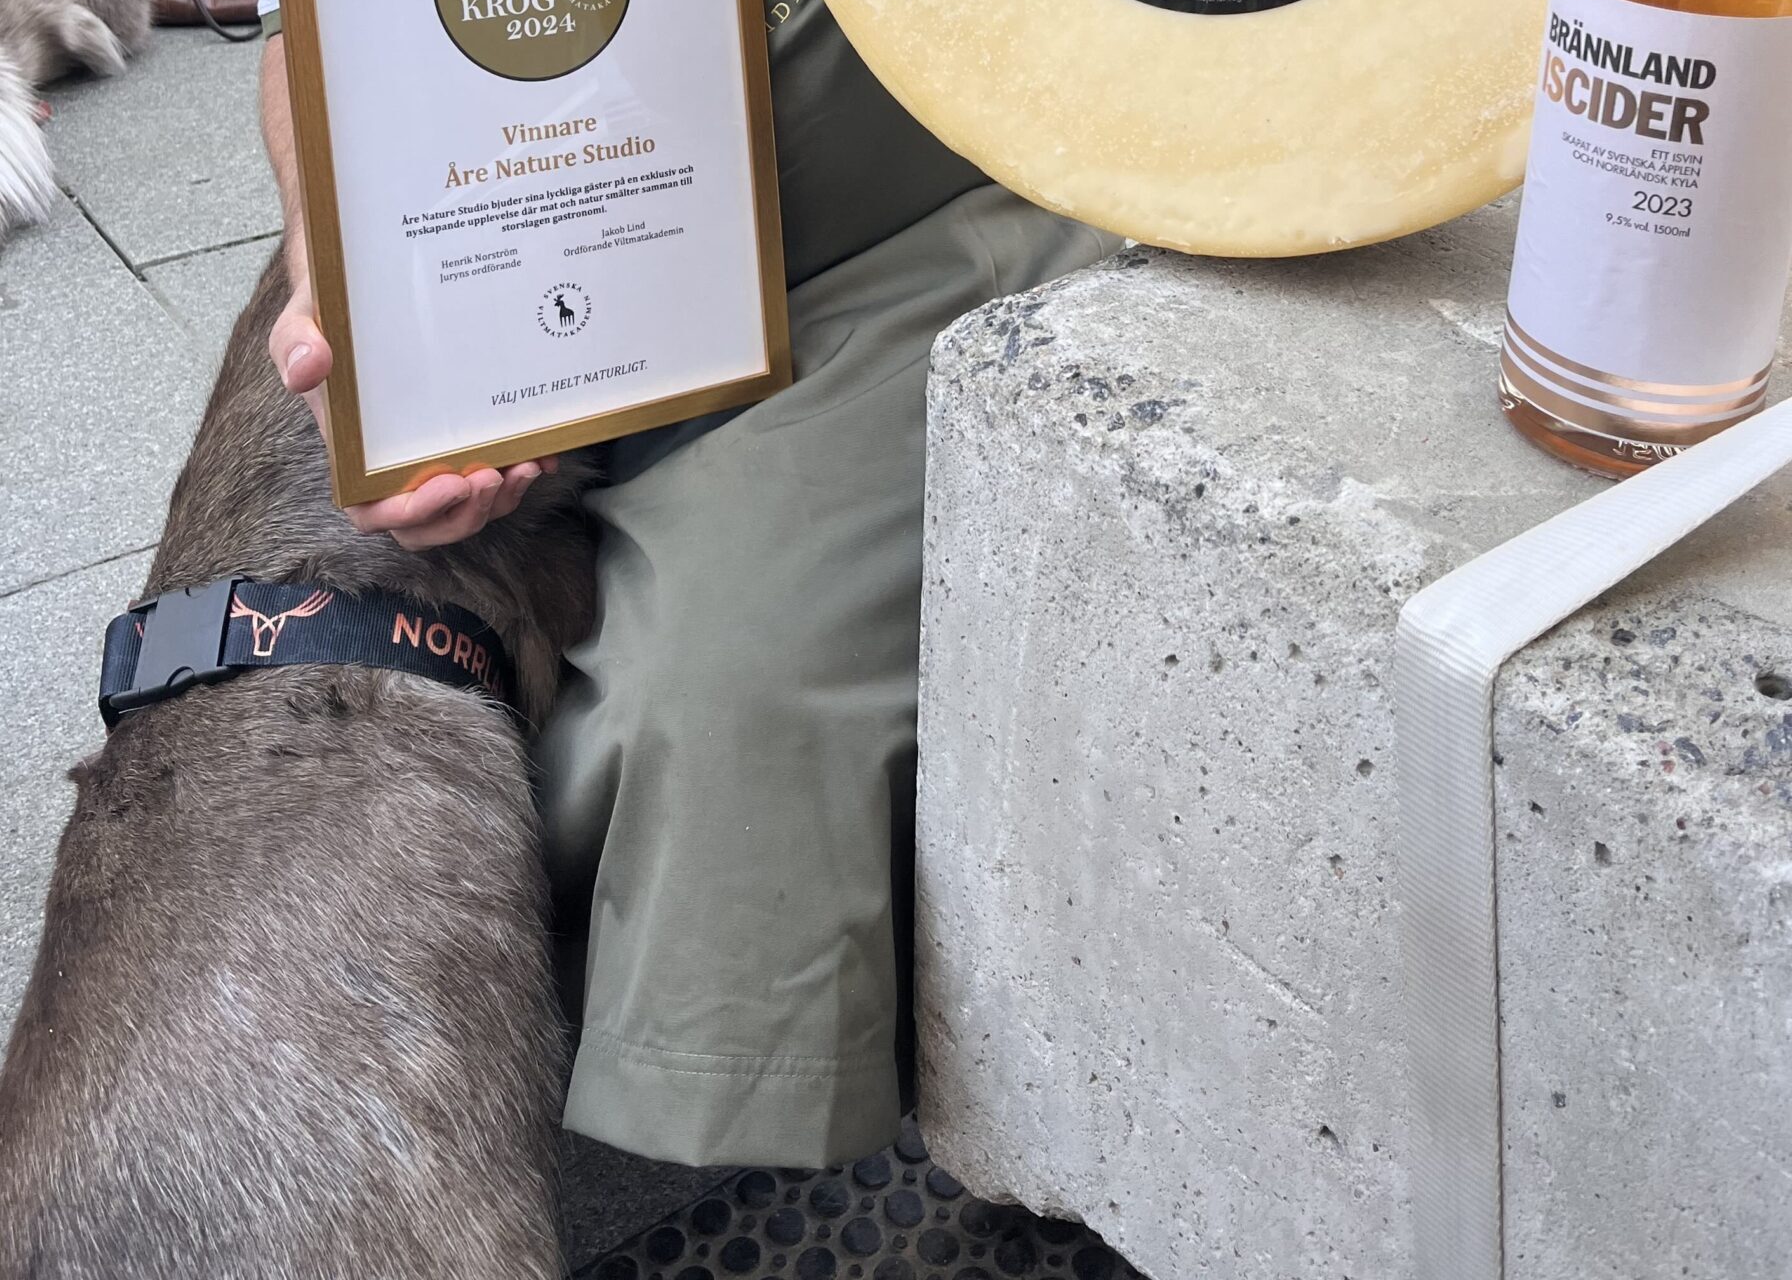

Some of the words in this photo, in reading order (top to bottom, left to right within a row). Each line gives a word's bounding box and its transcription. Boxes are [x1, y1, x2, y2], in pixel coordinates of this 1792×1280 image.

[506, 12, 576, 40] 2024
[1549, 12, 1717, 90] BRÄNNLAND
[1542, 49, 1711, 146] ISCIDER
[501, 116, 597, 145] Vinnare
[444, 161, 489, 189] Åre
[495, 152, 577, 180] Nature
[583, 136, 656, 164] Studio
[1562, 131, 1591, 152] SKAPAT
[1592, 146, 1606, 158] AV
[1607, 151, 1656, 171] SVENSKA
[1658, 159, 1701, 177] ÄPPLEN
[1572, 149, 1595, 166] OCH
[1595, 158, 1669, 186] NORRLÄNDSK
[1670, 177, 1699, 189] KYLA
[1651, 149, 1669, 161] ETT
[1672, 154, 1703, 165] ISVIN
[401, 214, 420, 226] Åre
[422, 208, 456, 222] Nature
[458, 202, 489, 216] Studio
[491, 196, 523, 210] bjuder
[525, 191, 545, 203] sina
[546, 186, 582, 201] lyckliga
[584, 179, 613, 194] gäster
[614, 176, 626, 188] på
[627, 175, 638, 184] en
[640, 168, 677, 181] exklusiv
[678, 164, 694, 175] och
[405, 218, 466, 239] nyskapande
[467, 210, 520, 228] upplevelse
[521, 205, 538, 216] där
[540, 201, 559, 213] mat
[560, 197, 577, 209] och
[579, 193, 604, 206] natur
[605, 187, 640, 201] smälter
[641, 181, 679, 194] samman
[680, 176, 693, 186] till
[1631, 190, 1693, 218] 2023
[501, 216, 551, 232] storslagen
[552, 204, 608, 225] gastronomi.
[601, 224, 626, 239] Jakob
[627, 220, 646, 233] Lind
[1605, 212, 1633, 228] 9,5%
[1633, 221, 1650, 233] vol.
[1653, 223, 1692, 238] 1500ml
[563, 240, 613, 257] Ordförande
[614, 226, 684, 247] Viltmatakademin
[440, 270, 470, 283] Juryns
[471, 258, 522, 276] ordförande
[441, 256, 473, 269] Henrik
[475, 248, 518, 263] Norström
[543, 282, 582, 299] SVENSKA
[537, 295, 592, 338] VILTMATAKADEMIN
[491, 390, 518, 406] VÄLJ
[520, 383, 549, 400] VILT.
[551, 375, 581, 392] HELT
[583, 359, 648, 384] NATURLIGT.
